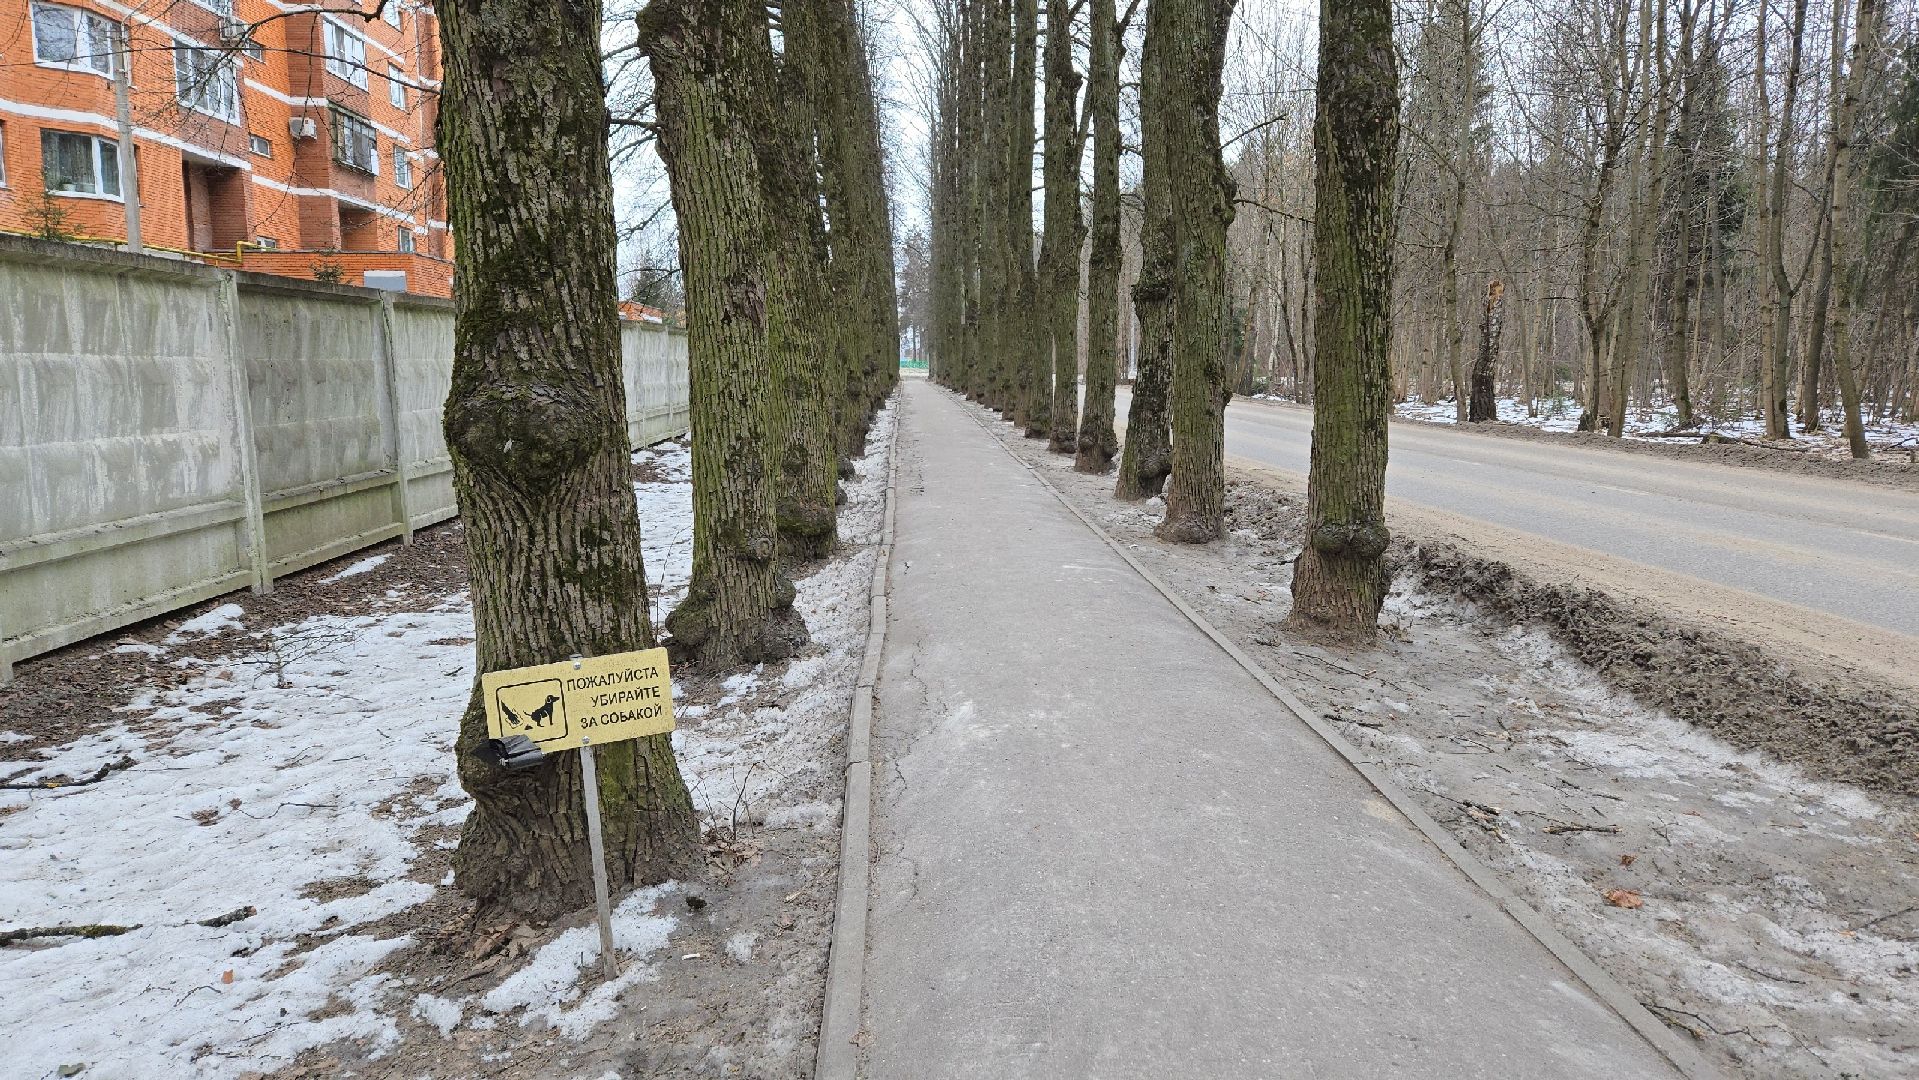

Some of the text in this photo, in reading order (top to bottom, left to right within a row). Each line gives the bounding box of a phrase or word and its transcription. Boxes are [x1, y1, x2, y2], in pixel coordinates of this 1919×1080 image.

[567, 666, 659, 691] ПОЖАЛУЙСТА
[591, 686, 660, 707] УБИРАЙТЕ
[580, 704, 662, 729] ЗА СОБАКОЙ
